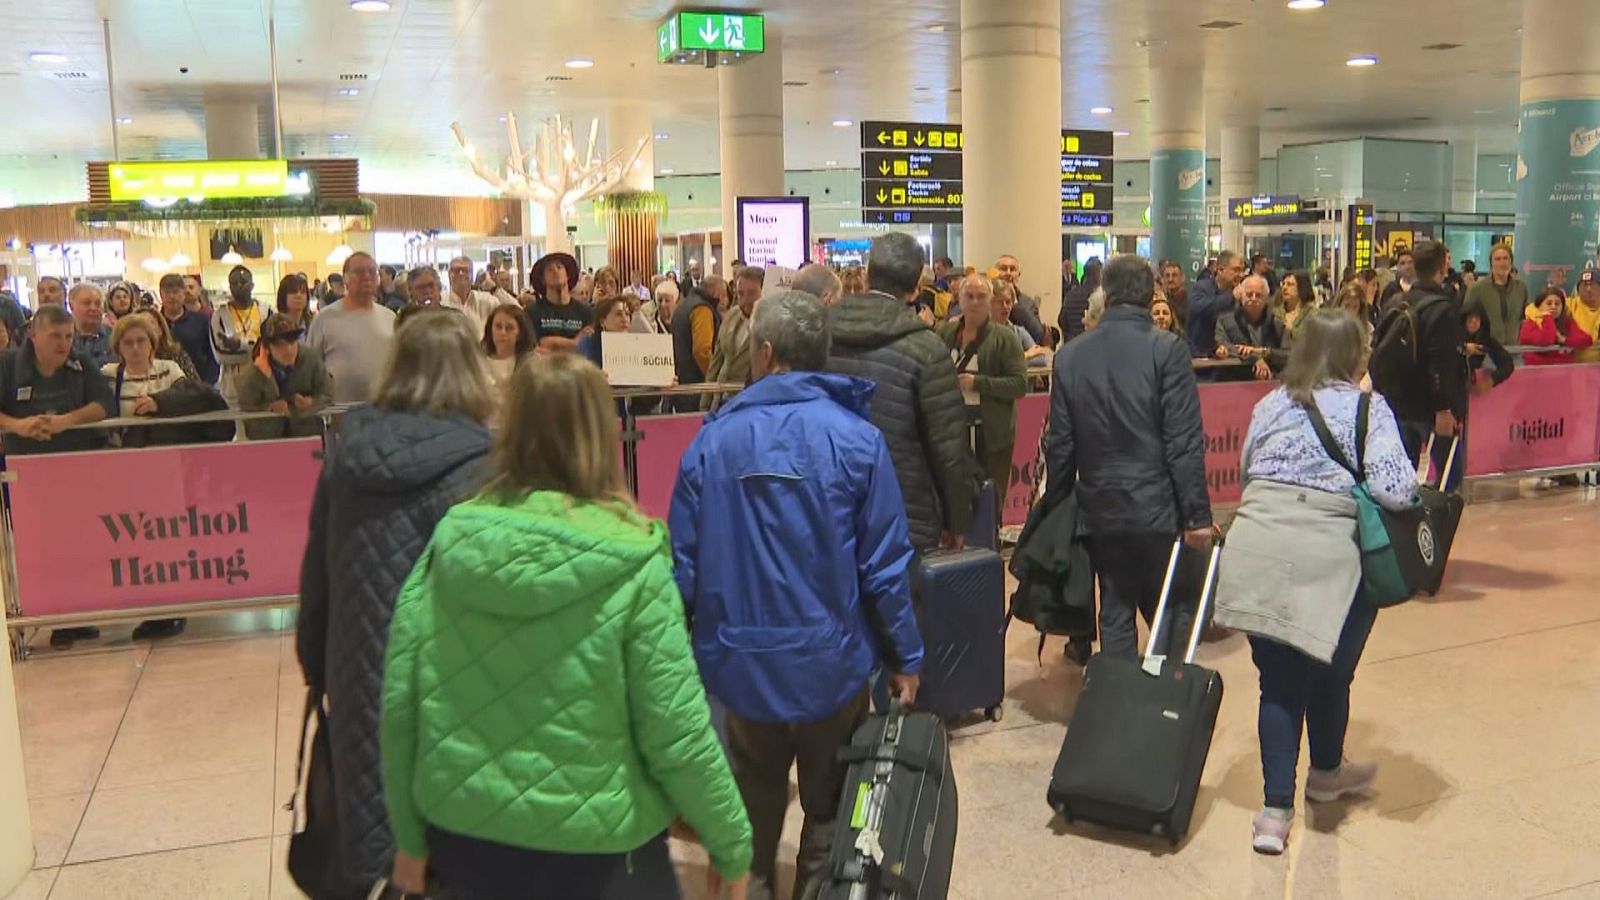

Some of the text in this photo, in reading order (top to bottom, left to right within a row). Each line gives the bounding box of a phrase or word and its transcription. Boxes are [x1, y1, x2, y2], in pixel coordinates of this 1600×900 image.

[908, 181, 941, 190] Facturació
[1549, 193, 1582, 202] Airport
[750, 214, 778, 224] Moco
[1073, 214, 1092, 224] Plaça
[1508, 416, 1564, 445] Digital
[98, 502, 249, 543] Warhol
[110, 548, 249, 586] Haring
